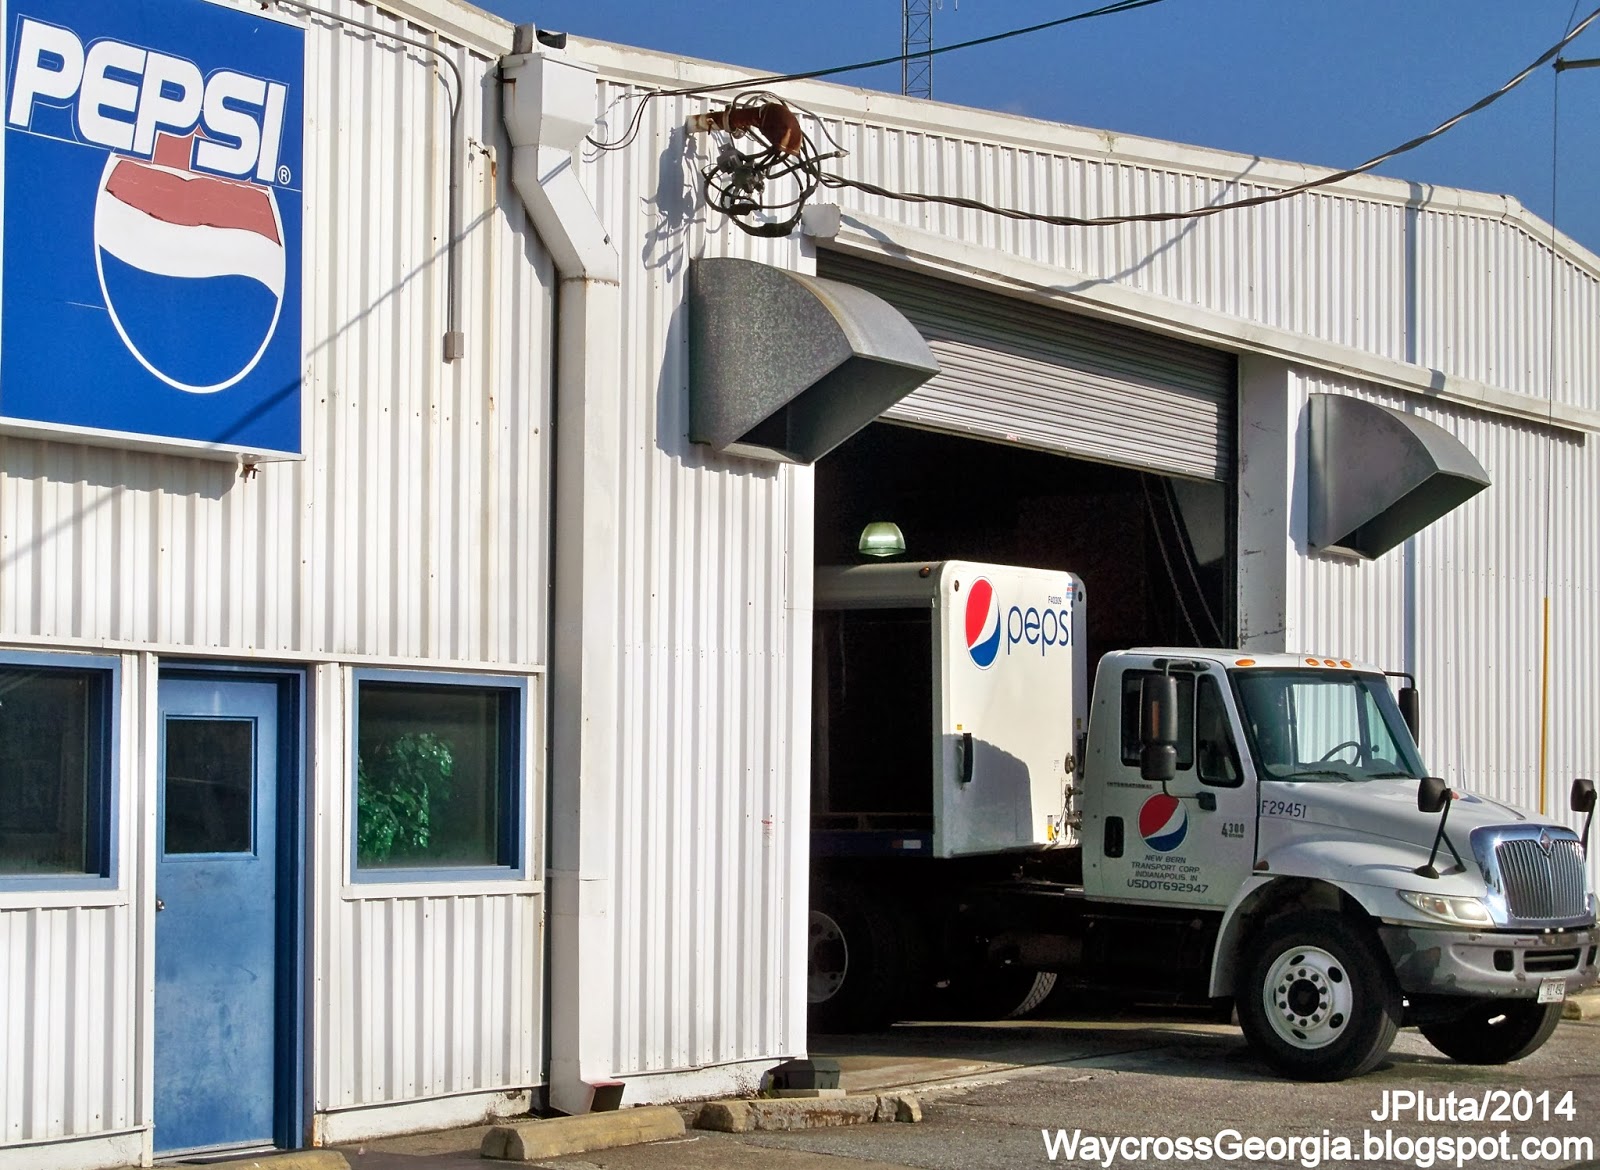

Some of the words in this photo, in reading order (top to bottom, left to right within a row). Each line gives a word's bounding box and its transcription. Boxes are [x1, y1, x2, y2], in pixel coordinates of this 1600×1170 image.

[9, 18, 288, 183] PEPSI
[1261, 800, 1306, 819] F29451
[1131, 861, 1176, 872] TRANSPORT
[1144, 854, 1164, 862] NEW
[1165, 855, 1187, 864] BERN
[1126, 878, 1209, 894] USDOT692947
